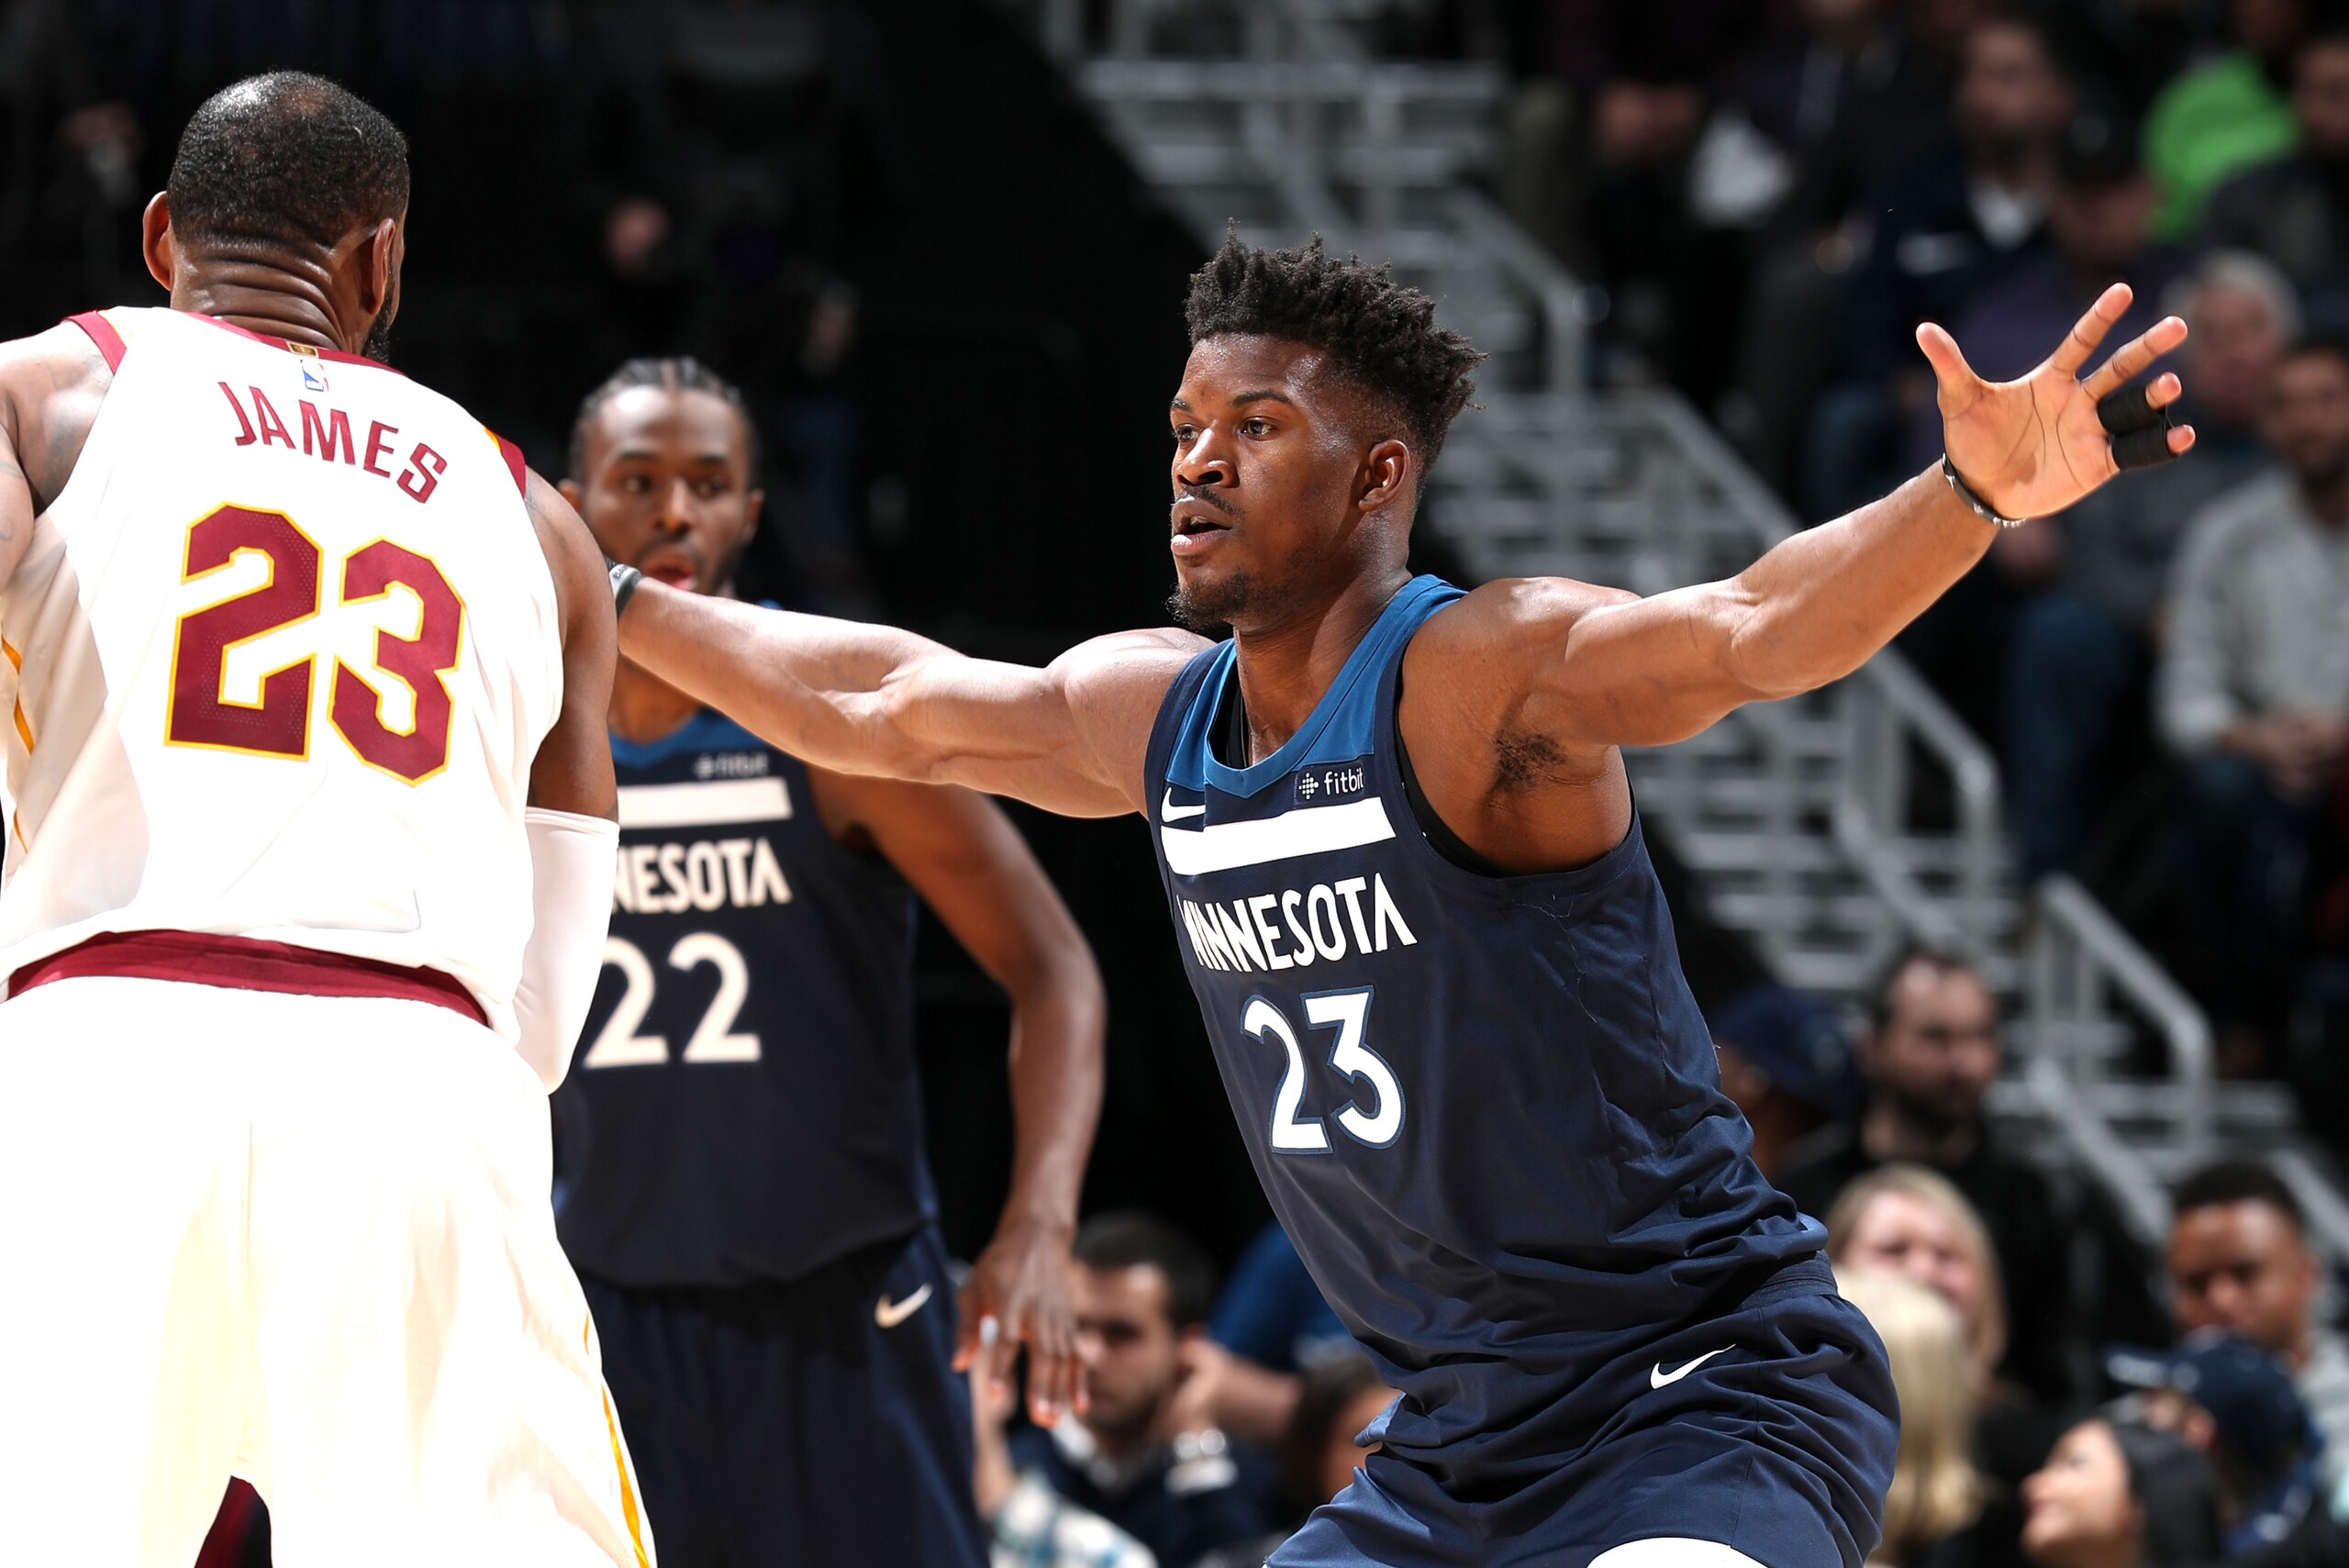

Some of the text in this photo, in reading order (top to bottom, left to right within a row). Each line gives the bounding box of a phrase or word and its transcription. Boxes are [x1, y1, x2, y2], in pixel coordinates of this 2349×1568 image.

[217, 381, 448, 504] JAMES
[163, 500, 467, 788] 23
[1323, 767, 1364, 795] fitbit
[1176, 872, 1418, 973] MINNESOTA
[583, 931, 763, 1070] 22
[1240, 984, 1407, 1155] 23
